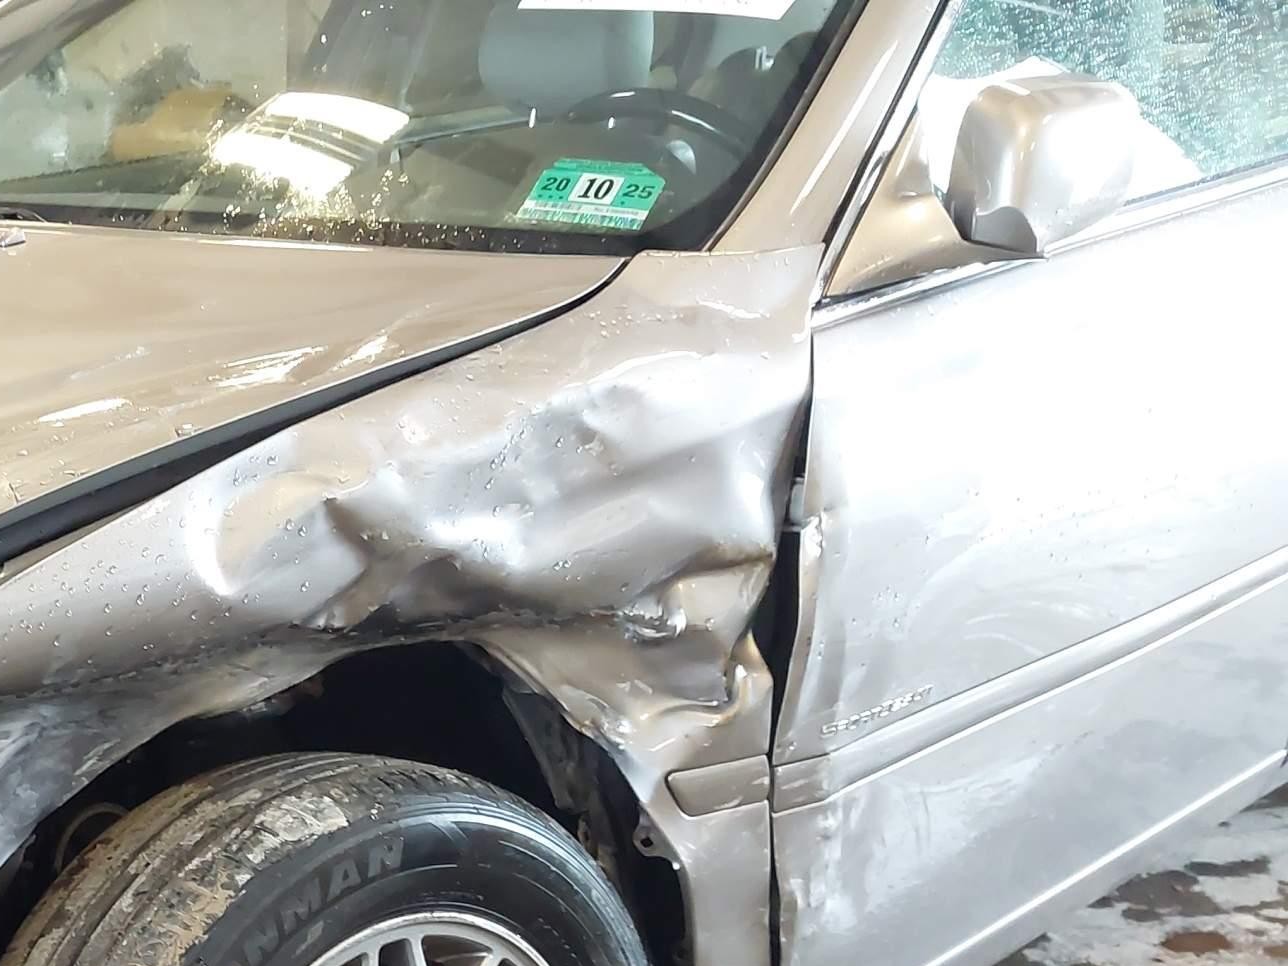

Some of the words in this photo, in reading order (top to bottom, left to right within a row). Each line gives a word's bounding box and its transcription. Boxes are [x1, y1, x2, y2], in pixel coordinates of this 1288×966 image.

[541, 177, 571, 192] 20
[577, 177, 615, 201] 10
[622, 184, 655, 199] 25
